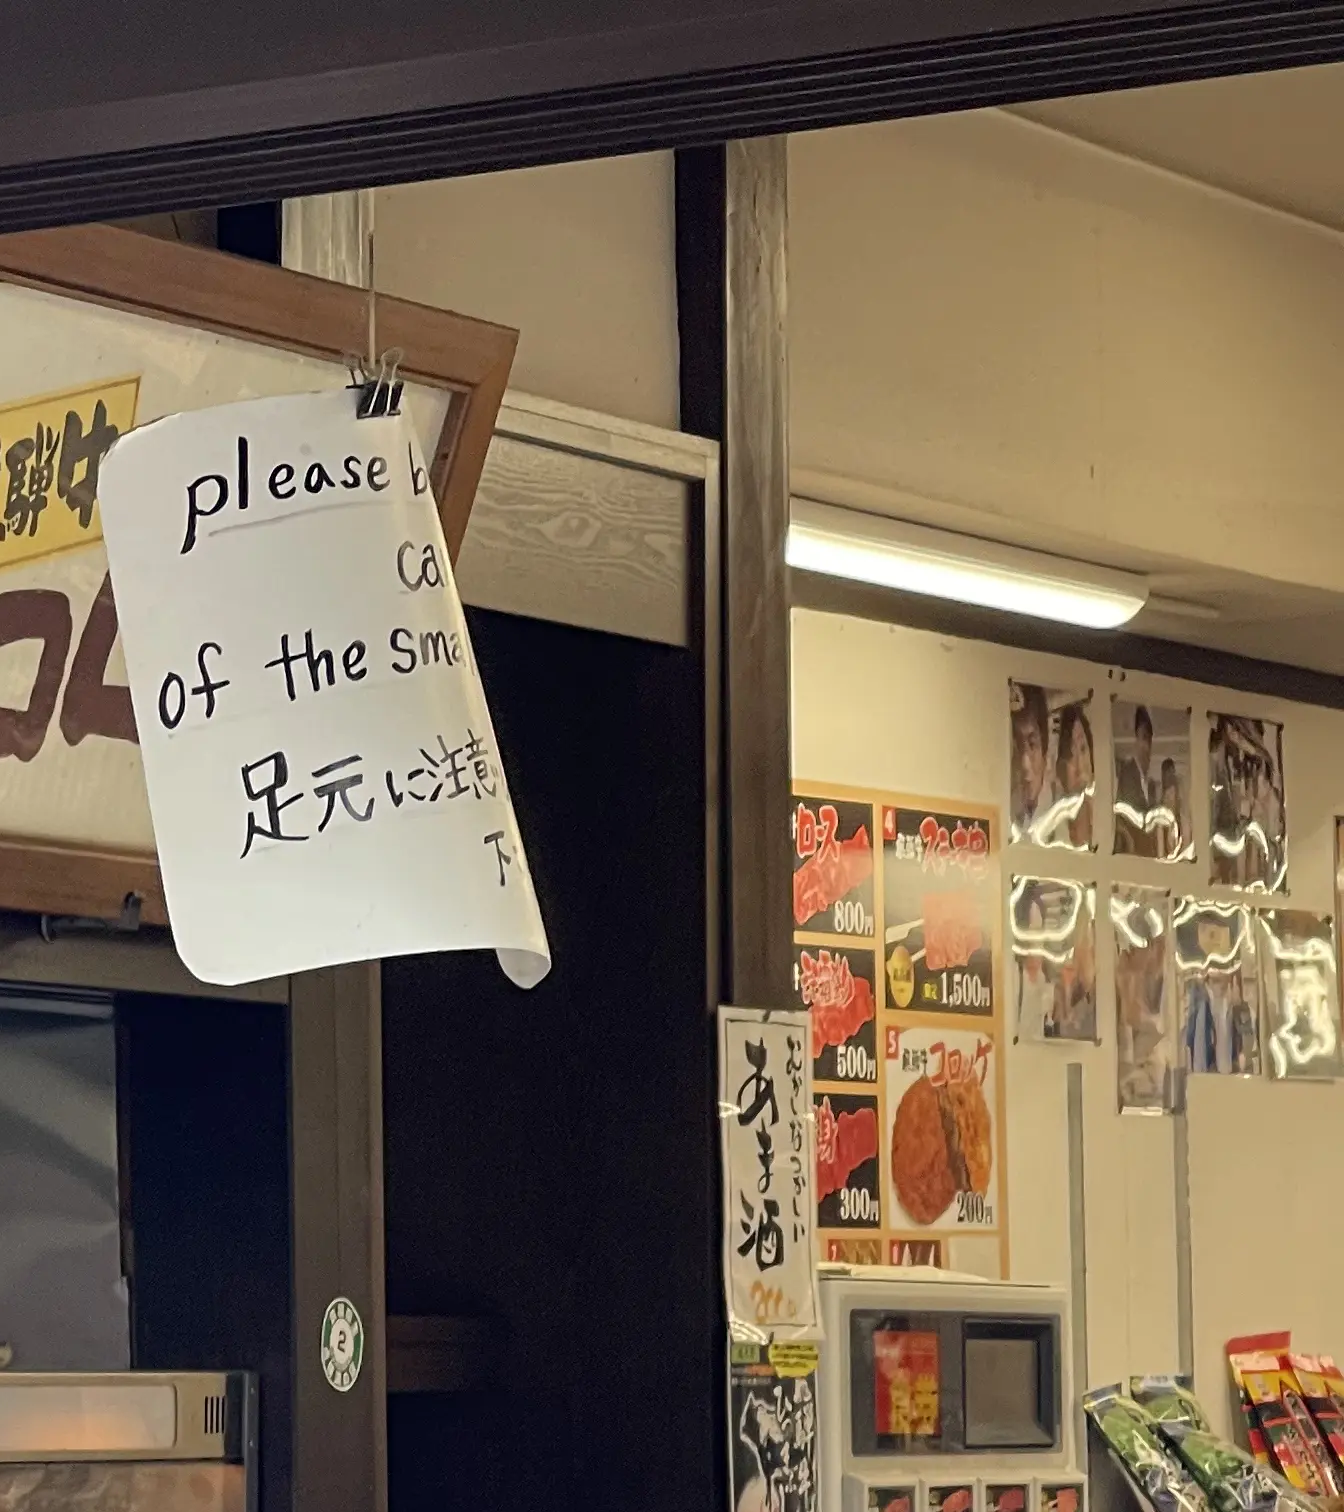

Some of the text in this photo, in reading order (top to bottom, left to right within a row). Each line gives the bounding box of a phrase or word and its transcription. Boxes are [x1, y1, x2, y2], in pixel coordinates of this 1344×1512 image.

[180, 436, 392, 555] please
[158, 641, 230, 730] of
[264, 633, 369, 702] the
[794, 802, 842, 864] ロース
[833, 901, 874, 936] 800円
[939, 971, 991, 1008] 1,500円
[836, 1044, 877, 1082] 500円
[928, 1038, 994, 1087] コロッケ
[736, 1035, 785, 1273] あま酒
[839, 1186, 880, 1223] 300円
[955, 1191, 994, 1225] 200円
[337, 1330, 347, 1353] 2
